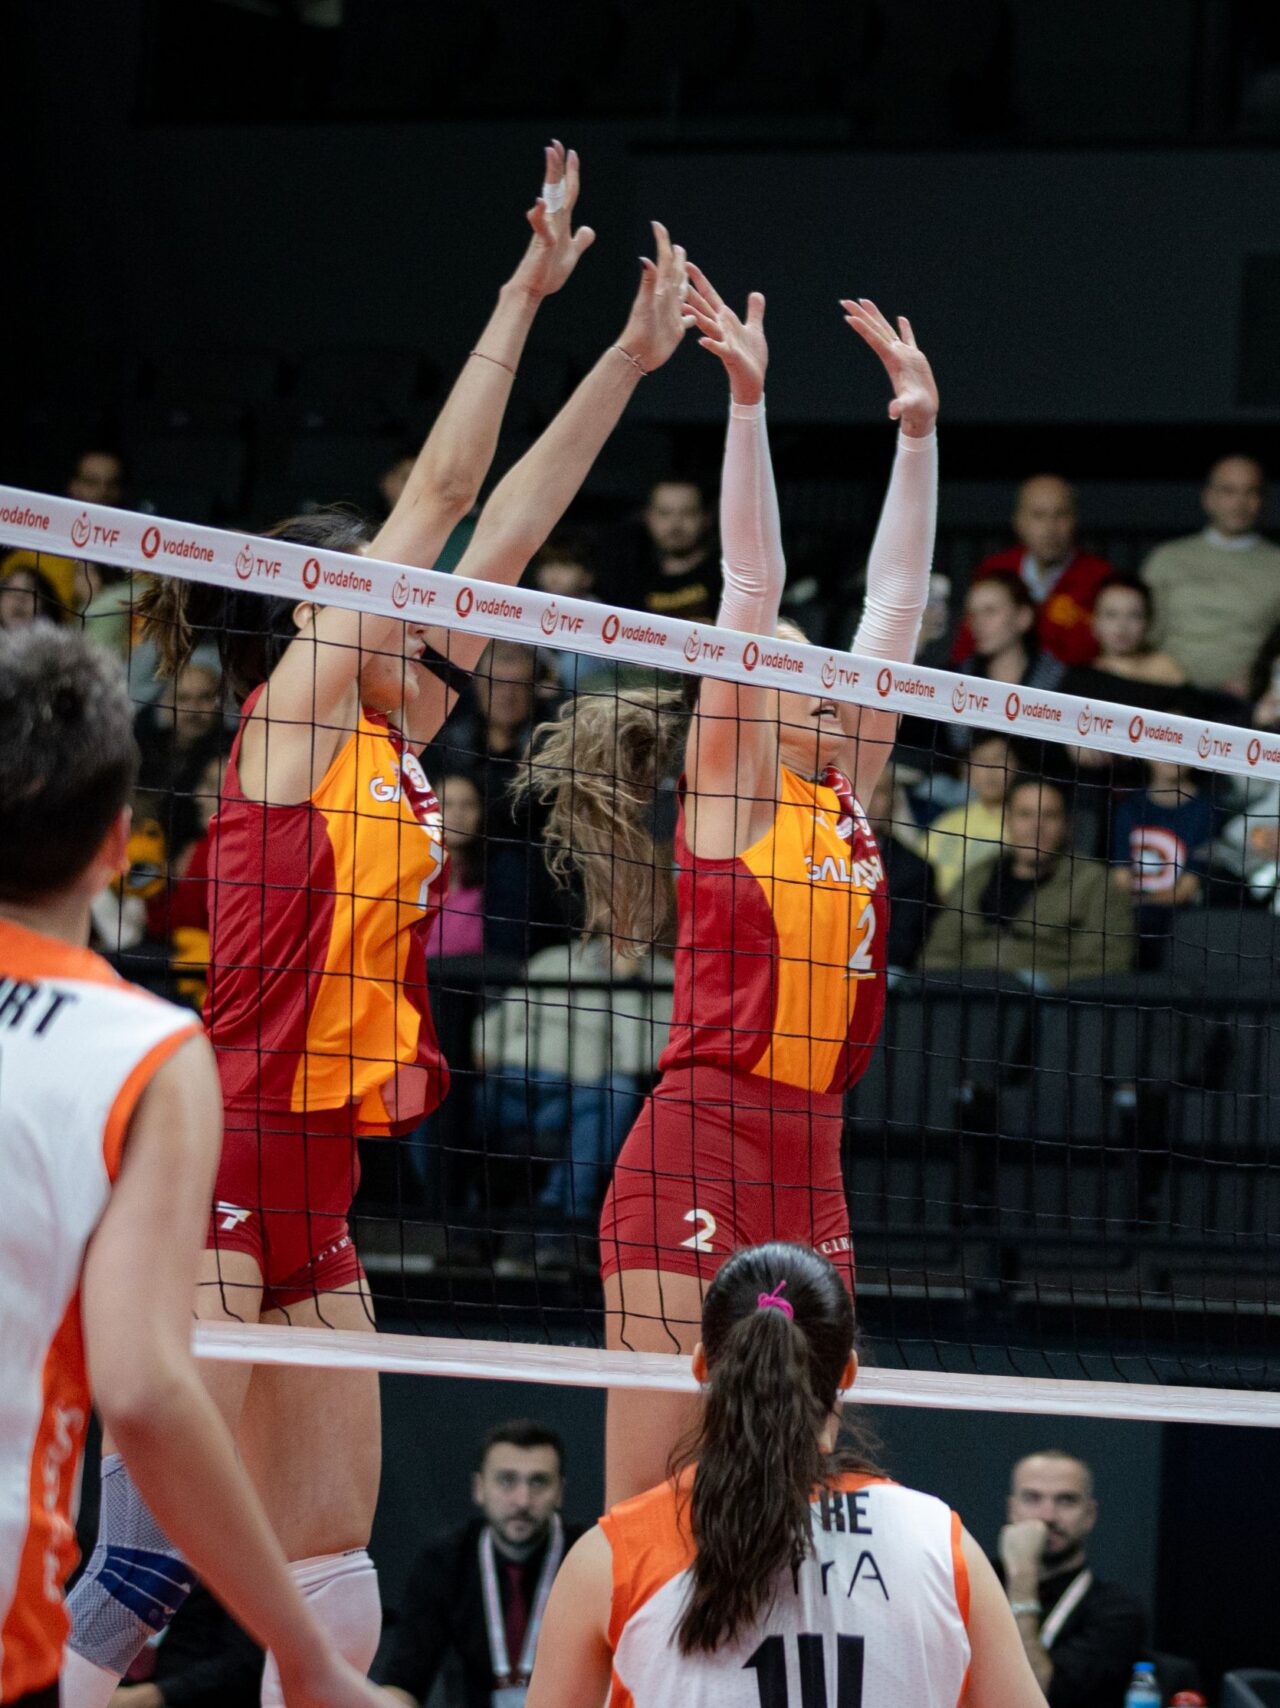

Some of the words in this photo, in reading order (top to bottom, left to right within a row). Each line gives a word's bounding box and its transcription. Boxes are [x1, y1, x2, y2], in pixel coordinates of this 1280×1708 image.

[93, 526, 120, 547] TVF
[163, 539, 214, 562] vodafone
[256, 558, 282, 580] TVF
[323, 569, 372, 592] vodafone
[412, 587, 437, 608] TVF
[475, 597, 523, 619] vodafone
[560, 614, 584, 635] TVF
[621, 626, 667, 646] vodafone
[702, 642, 725, 662] TVF
[761, 652, 804, 673] vodafone
[838, 669, 860, 688] TVF
[894, 678, 935, 698] vodafone
[968, 694, 989, 712] TVF
[1021, 702, 1062, 721] vodafone
[1094, 716, 1114, 734] TVF
[1144, 725, 1183, 744] vodafone
[1214, 740, 1232, 757] TVF
[847, 902, 877, 976] 2
[0, 975, 80, 1035] RT
[680, 1208, 716, 1253] 2
